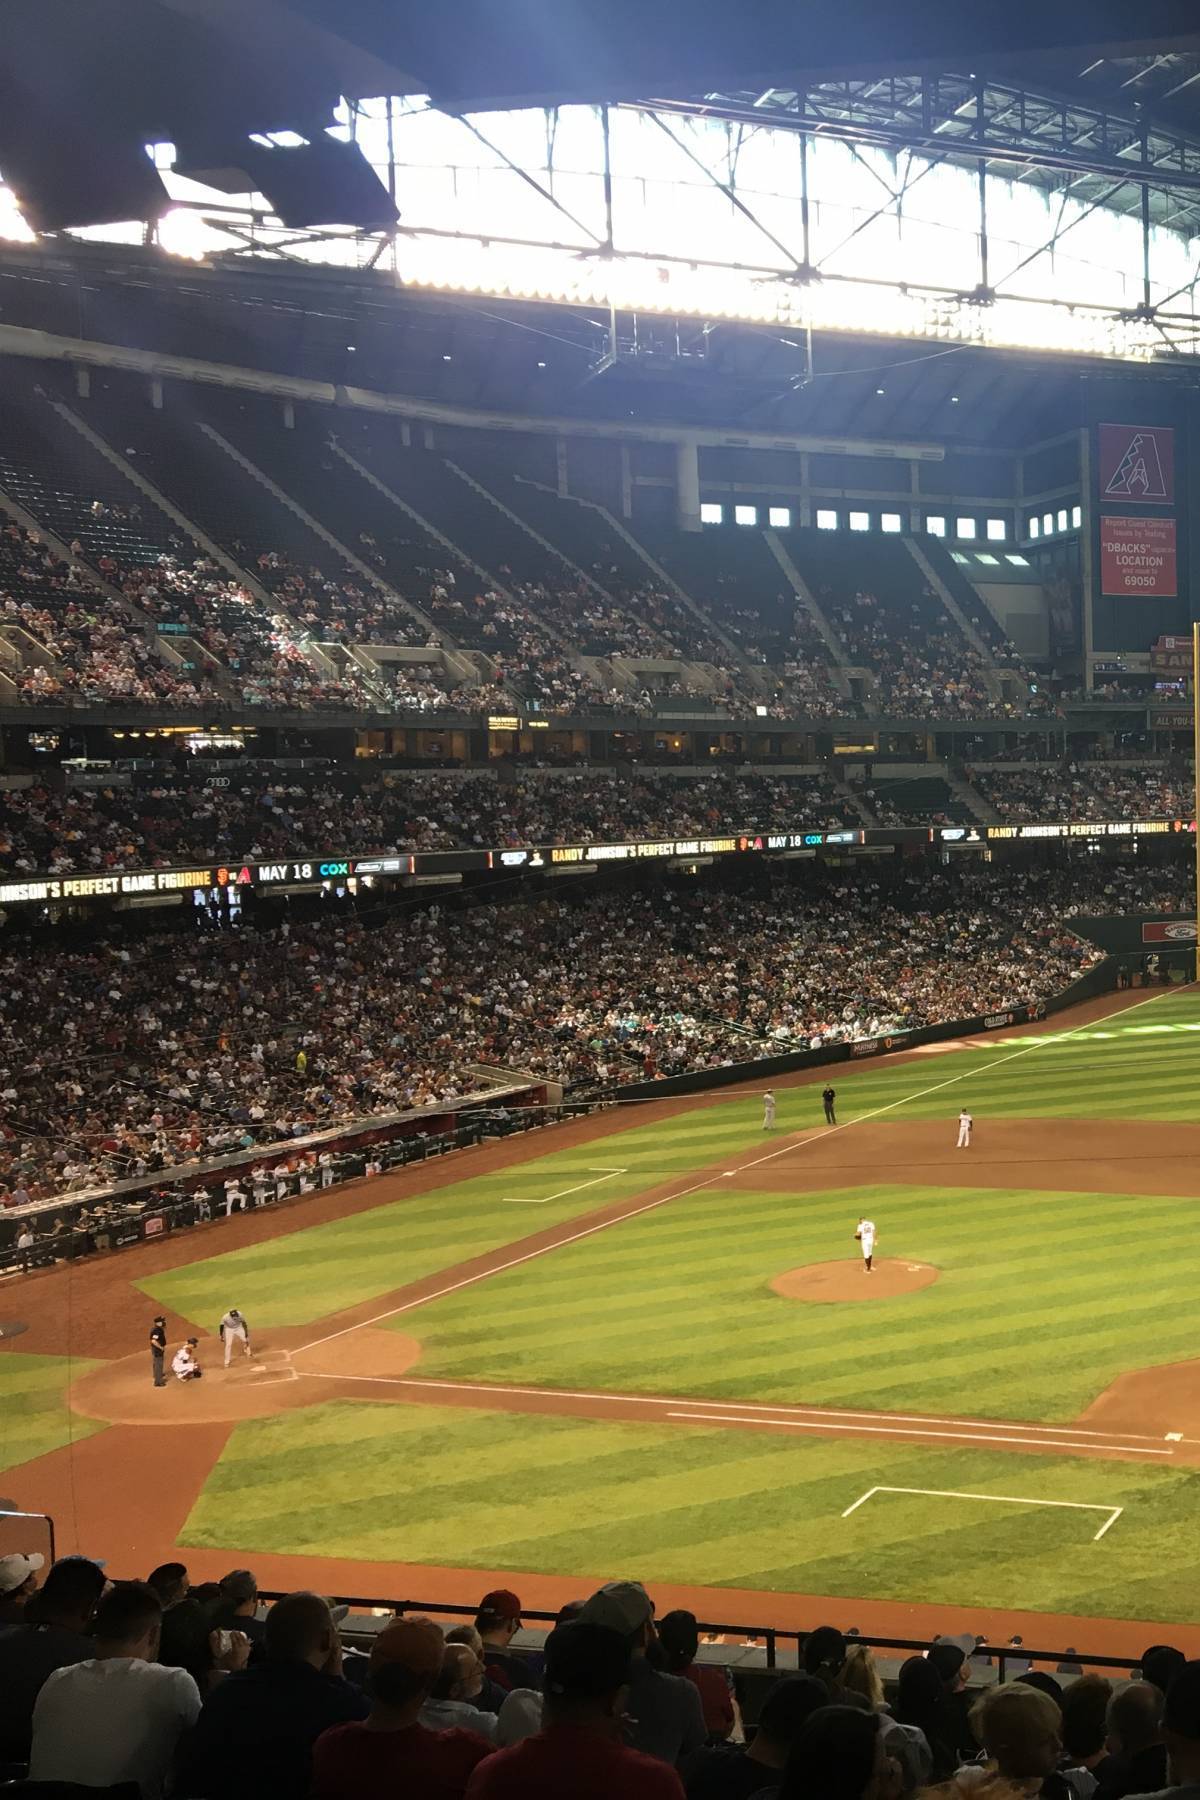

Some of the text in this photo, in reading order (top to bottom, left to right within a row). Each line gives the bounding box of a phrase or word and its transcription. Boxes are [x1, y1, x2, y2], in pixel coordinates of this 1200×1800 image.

[1102, 542, 1150, 554] "DBACKS"
[1116, 555, 1163, 566] LOCATION
[1124, 576, 1156, 586] 69050
[988, 822, 1170, 838] RANDY JOHNSON'S PERFECT GAME FIGURINE
[768, 836, 788, 848] MAY
[790, 836, 800, 847] 18
[806, 834, 822, 844] COX
[552, 840, 736, 862] RANDY JOHNSON'S PERFECT GAME FIGURINE
[259, 866, 288, 881] MAY
[293, 864, 312, 878] 18
[320, 863, 348, 876] COX
[63, 870, 211, 896] PERFECT GAME FIGURINE
